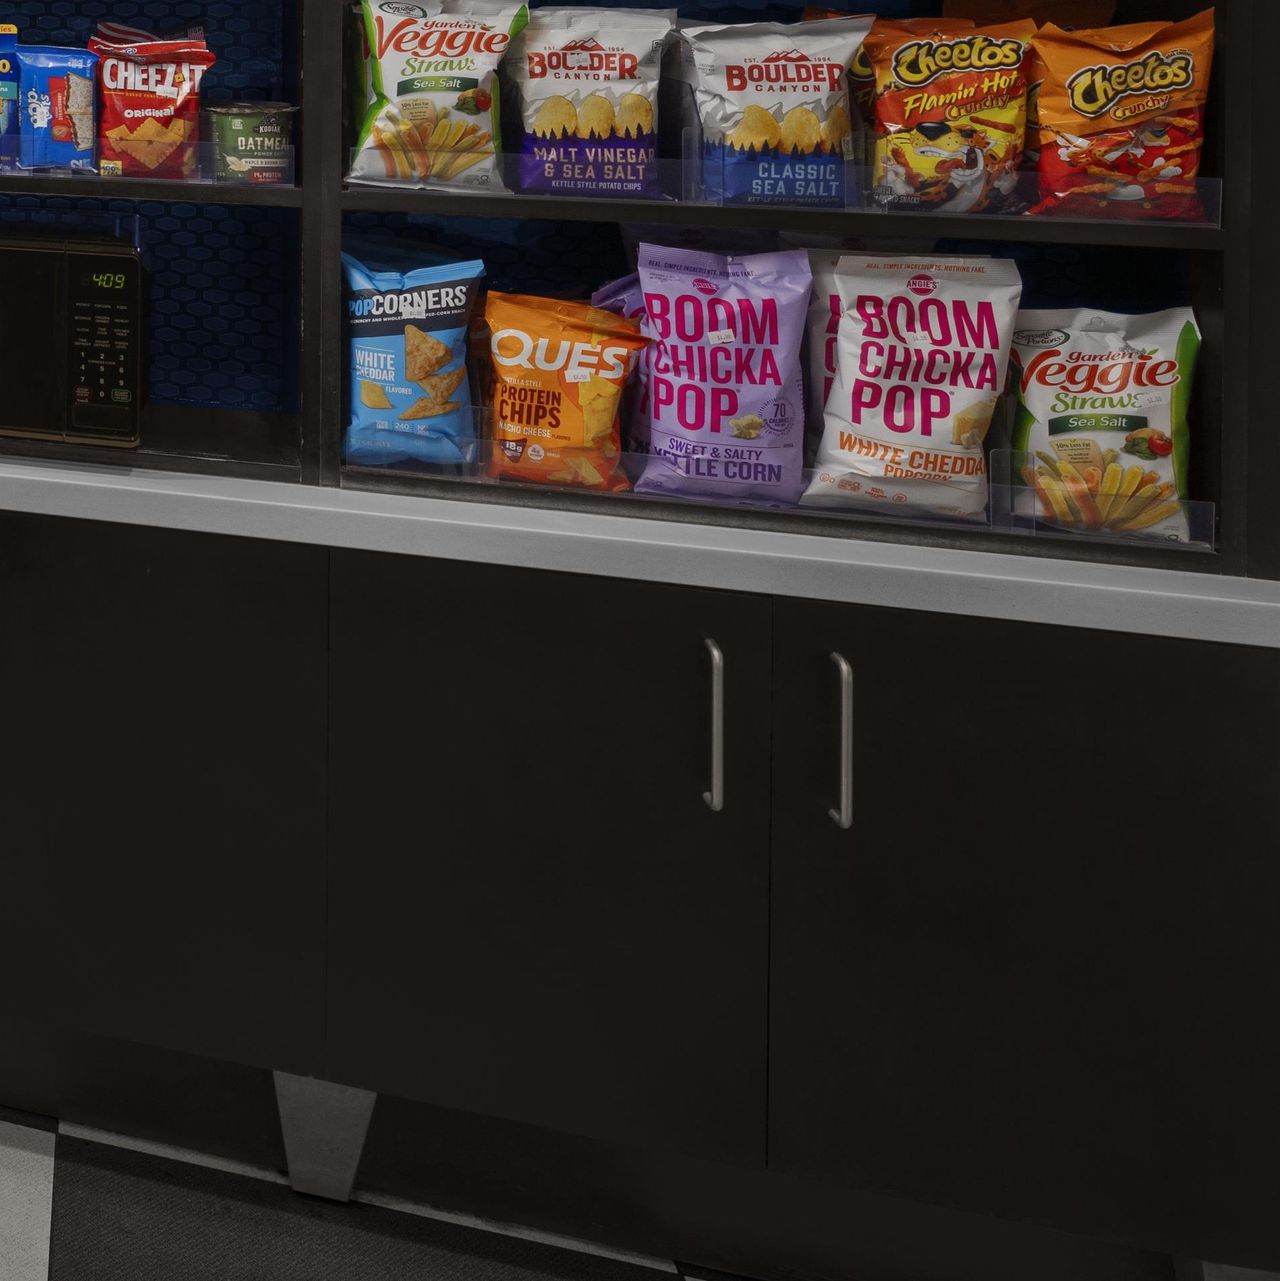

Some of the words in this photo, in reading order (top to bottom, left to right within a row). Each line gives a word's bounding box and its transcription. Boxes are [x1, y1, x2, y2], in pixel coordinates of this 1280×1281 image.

[374, 16, 509, 57] Veggie
[528, 52, 638, 79] BOULDER
[894, 36, 1022, 86] Cheetos
[413, 79, 436, 89] Sea
[439, 77, 461, 88] Salt
[554, 73, 611, 81] CANYON
[755, 82, 822, 92] CANYON
[1070, 53, 1191, 116] Cheetos
[945, 93, 1010, 120] Crunchy
[535, 147, 579, 163] MALT
[585, 148, 654, 164] VINEGAR
[544, 163, 554, 176] &
[562, 164, 597, 178] SEA
[604, 165, 645, 180] SALT
[758, 162, 836, 179] CLASSIC
[752, 180, 790, 195] SEA
[645, 292, 779, 346] BOOM
[855, 295, 999, 350] BOOM
[355, 350, 395, 371] WHITE
[655, 339, 783, 386] CHICKA
[858, 341, 998, 391] CHICKA
[1019, 349, 1180, 394] Veggie
[500, 385, 562, 407] PROTEIN
[653, 377, 739, 433] POP
[851, 379, 950, 437] POP
[499, 401, 561, 428] CHIPS
[721, 447, 763, 461] SALTY
